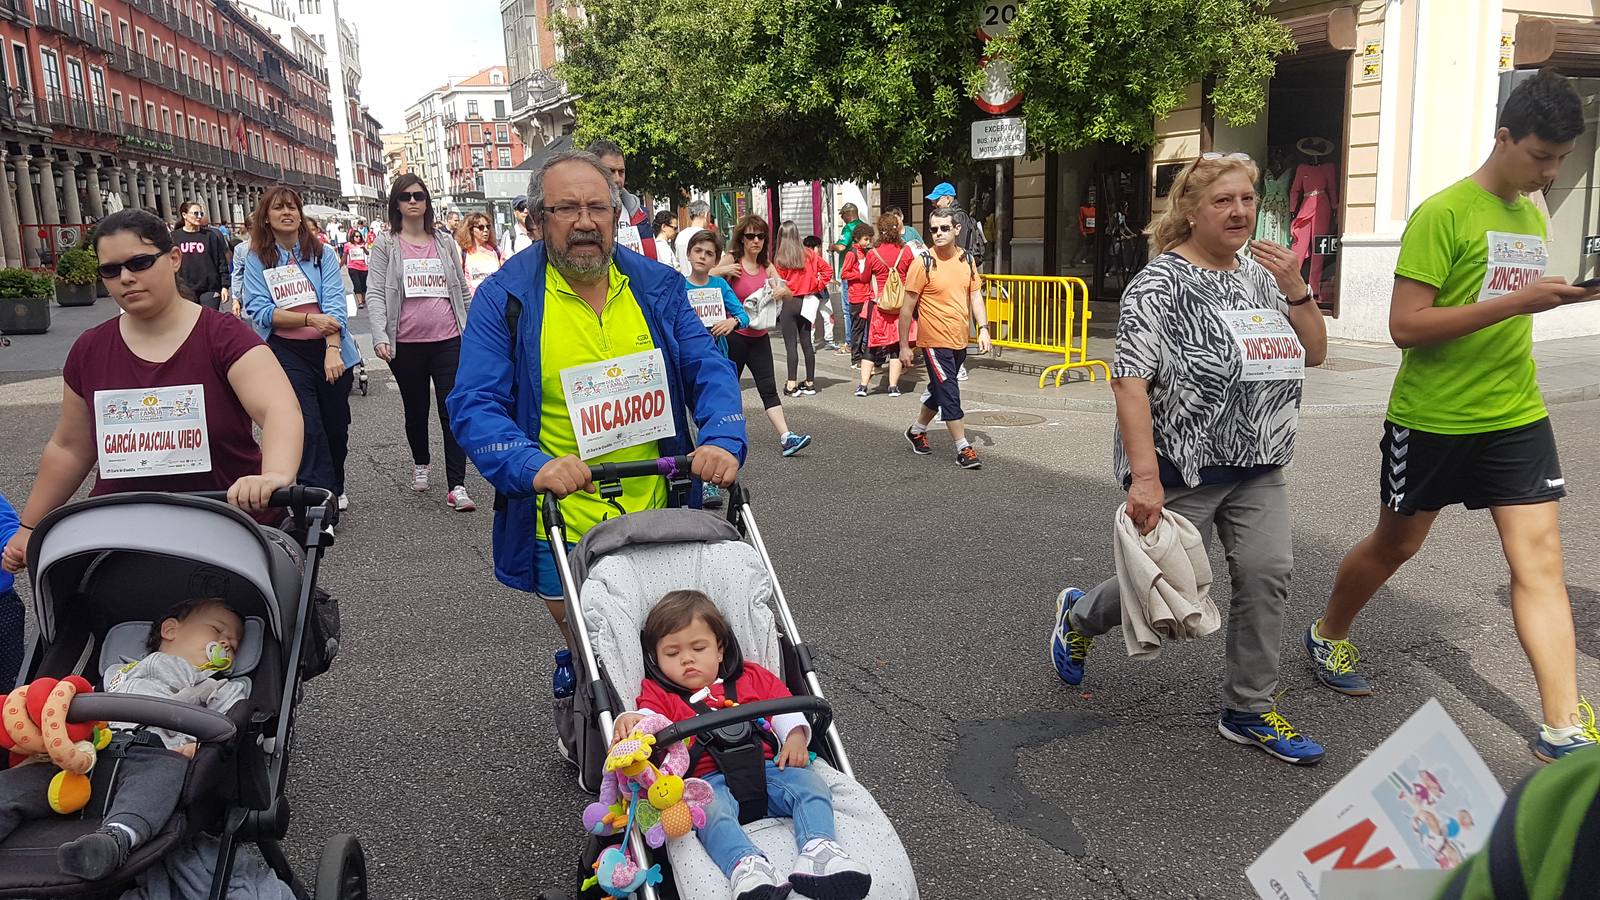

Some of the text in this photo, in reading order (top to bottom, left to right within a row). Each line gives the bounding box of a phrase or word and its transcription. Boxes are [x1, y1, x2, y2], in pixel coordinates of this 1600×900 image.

[985, 5, 1016, 25] 20
[984, 124, 1013, 133] EXCEPTO
[979, 145, 997, 153] MOTOS
[180, 242, 205, 253] UFO
[407, 274, 447, 288] DANILOVICH
[273, 279, 316, 300] DANILOVIC
[694, 304, 723, 318] NILOVICH
[580, 390, 666, 436] NICASROD
[105, 428, 202, 454] GARCÍA PASCUAL VIEJO
